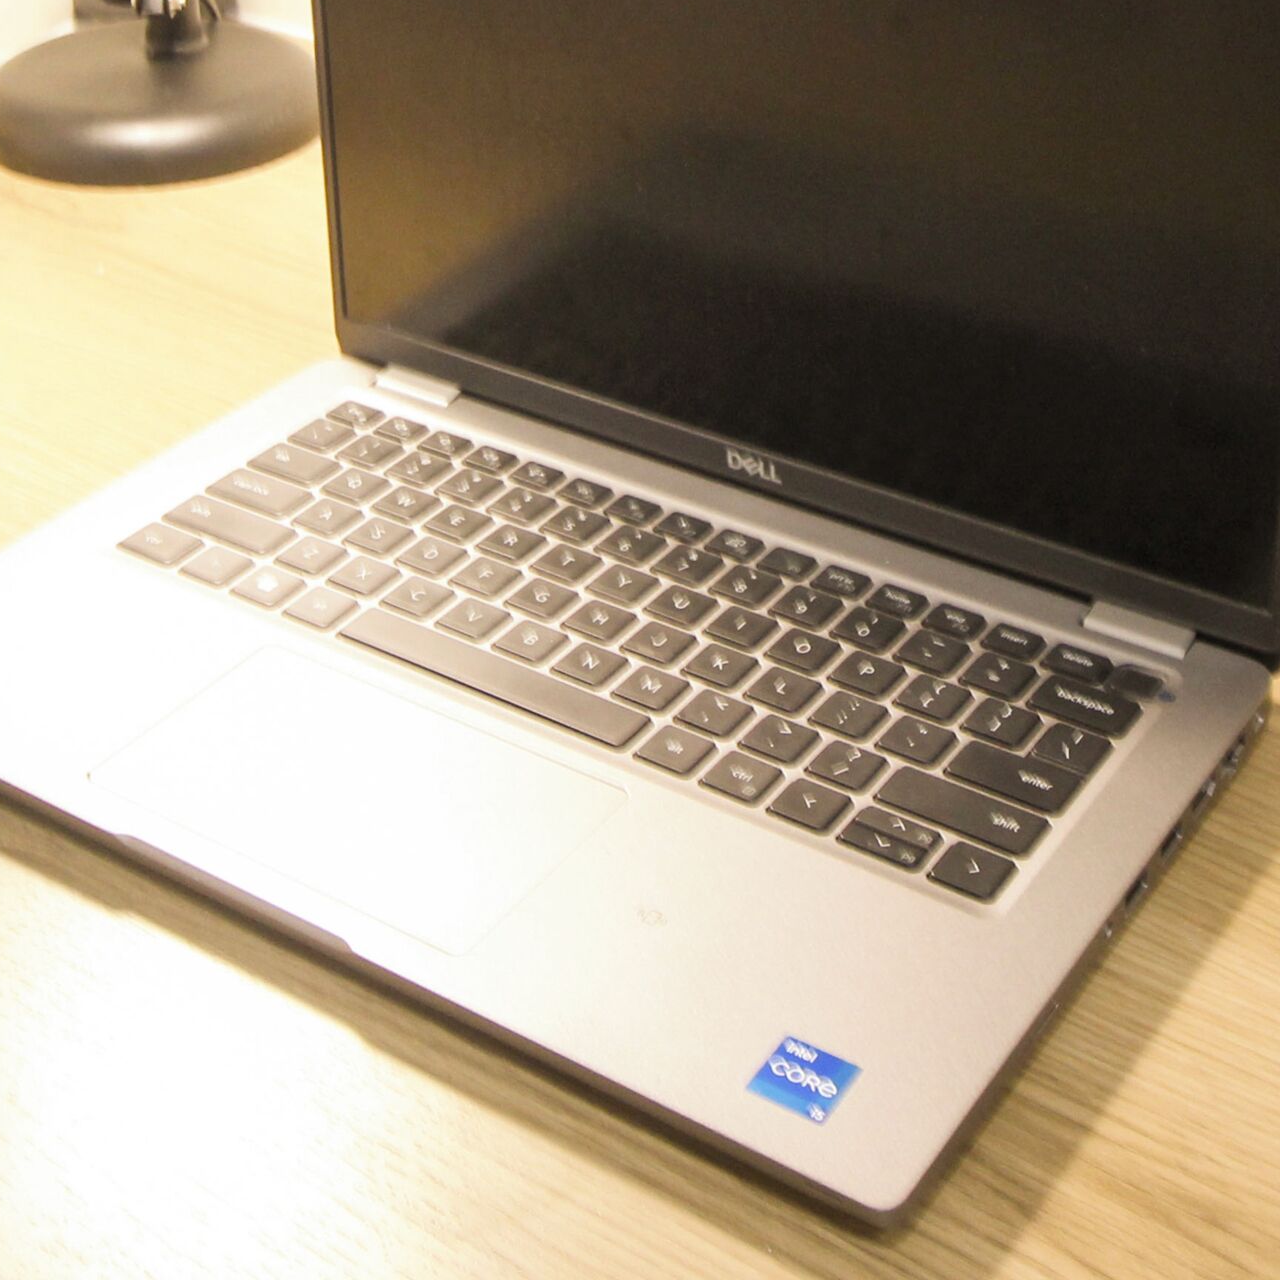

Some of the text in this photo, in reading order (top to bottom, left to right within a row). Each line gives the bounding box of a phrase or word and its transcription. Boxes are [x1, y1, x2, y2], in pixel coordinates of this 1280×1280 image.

[726, 446, 783, 485] DELL
[1056, 685, 1115, 716] backspace
[1020, 771, 1054, 792] enter
[991, 811, 1021, 833] shift
[784, 1038, 819, 1064] intel
